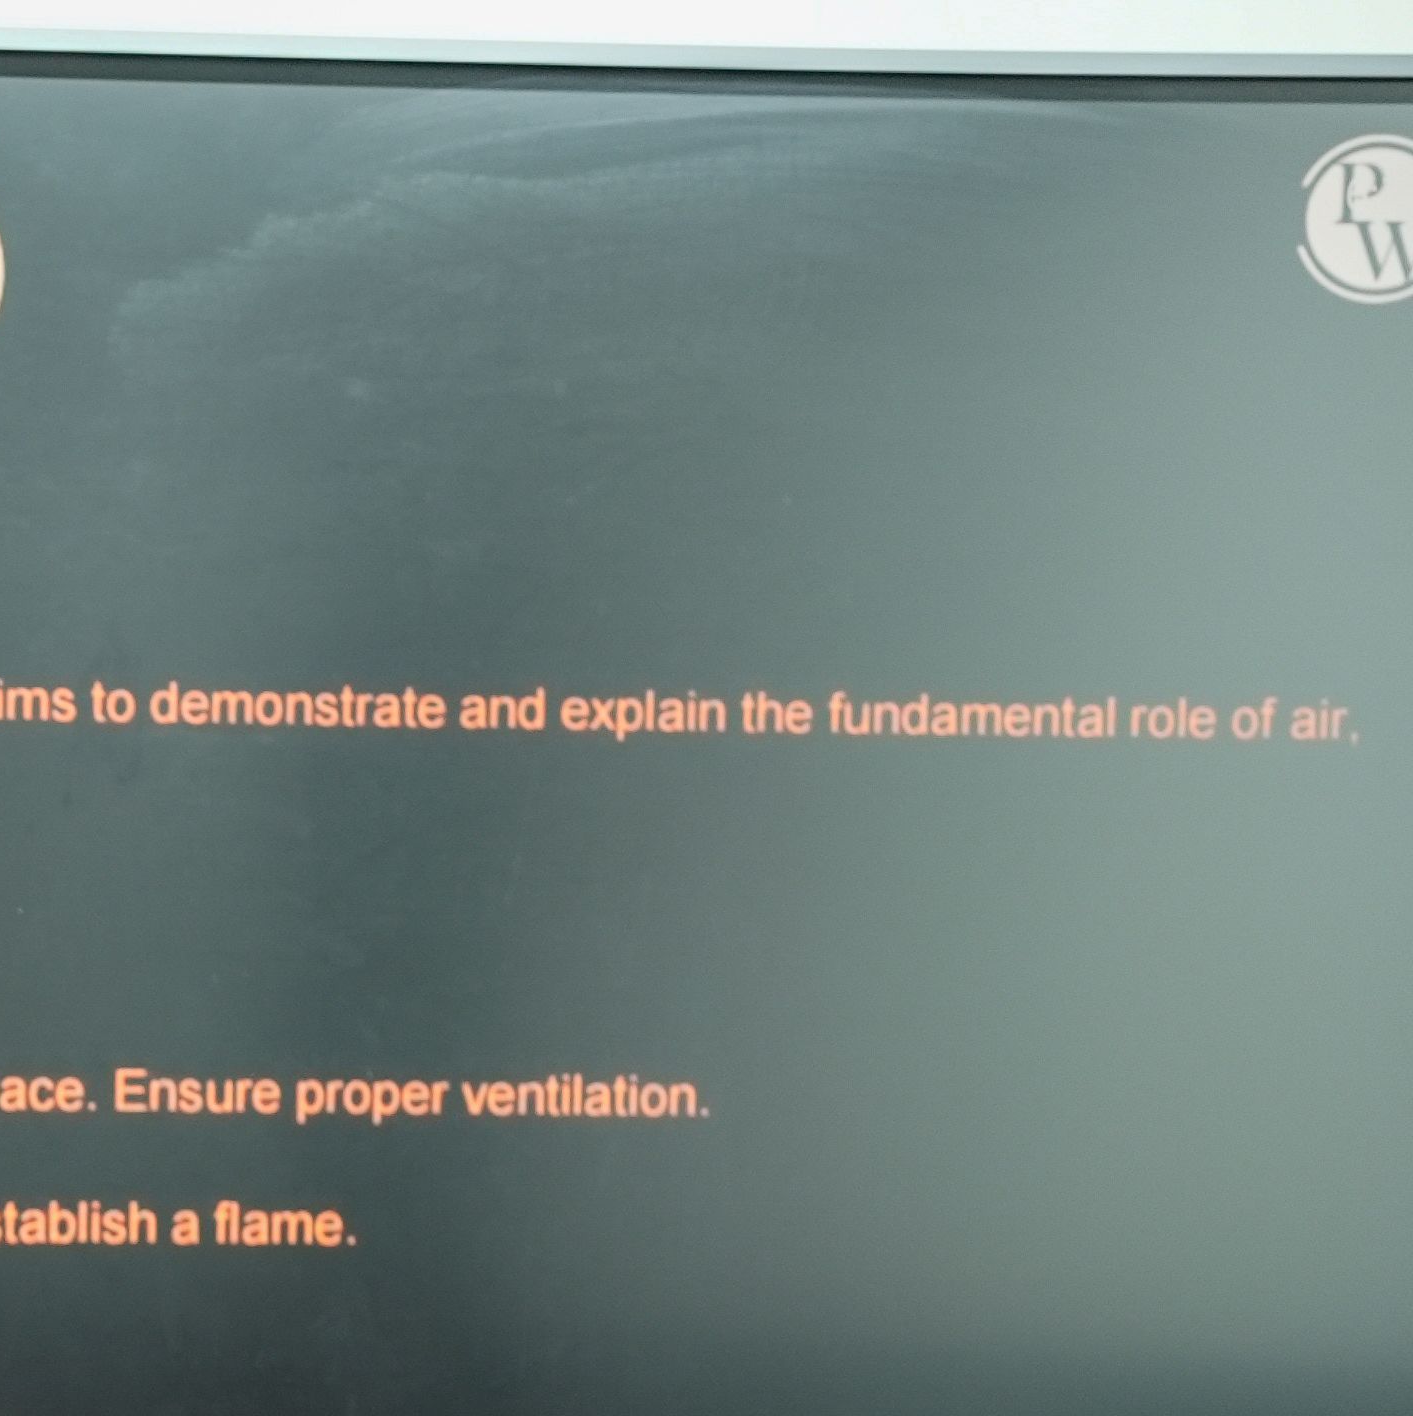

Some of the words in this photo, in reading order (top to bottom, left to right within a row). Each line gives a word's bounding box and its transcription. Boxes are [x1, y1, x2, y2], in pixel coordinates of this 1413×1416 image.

[90, 680, 137, 724] to
[149, 680, 448, 730] demonstrate
[459, 686, 547, 731] and
[559, 689, 727, 742] explain
[741, 690, 814, 735] the
[828, 690, 1117, 739] fundamental
[1130, 697, 1217, 740] role
[1231, 696, 1278, 740] of
[114, 1067, 282, 1115] Ensure
[295, 1078, 450, 1125] proper
[461, 1072, 709, 1118] ventilation.
[170, 1209, 201, 1246] a
[213, 1199, 356, 1248] flame.
